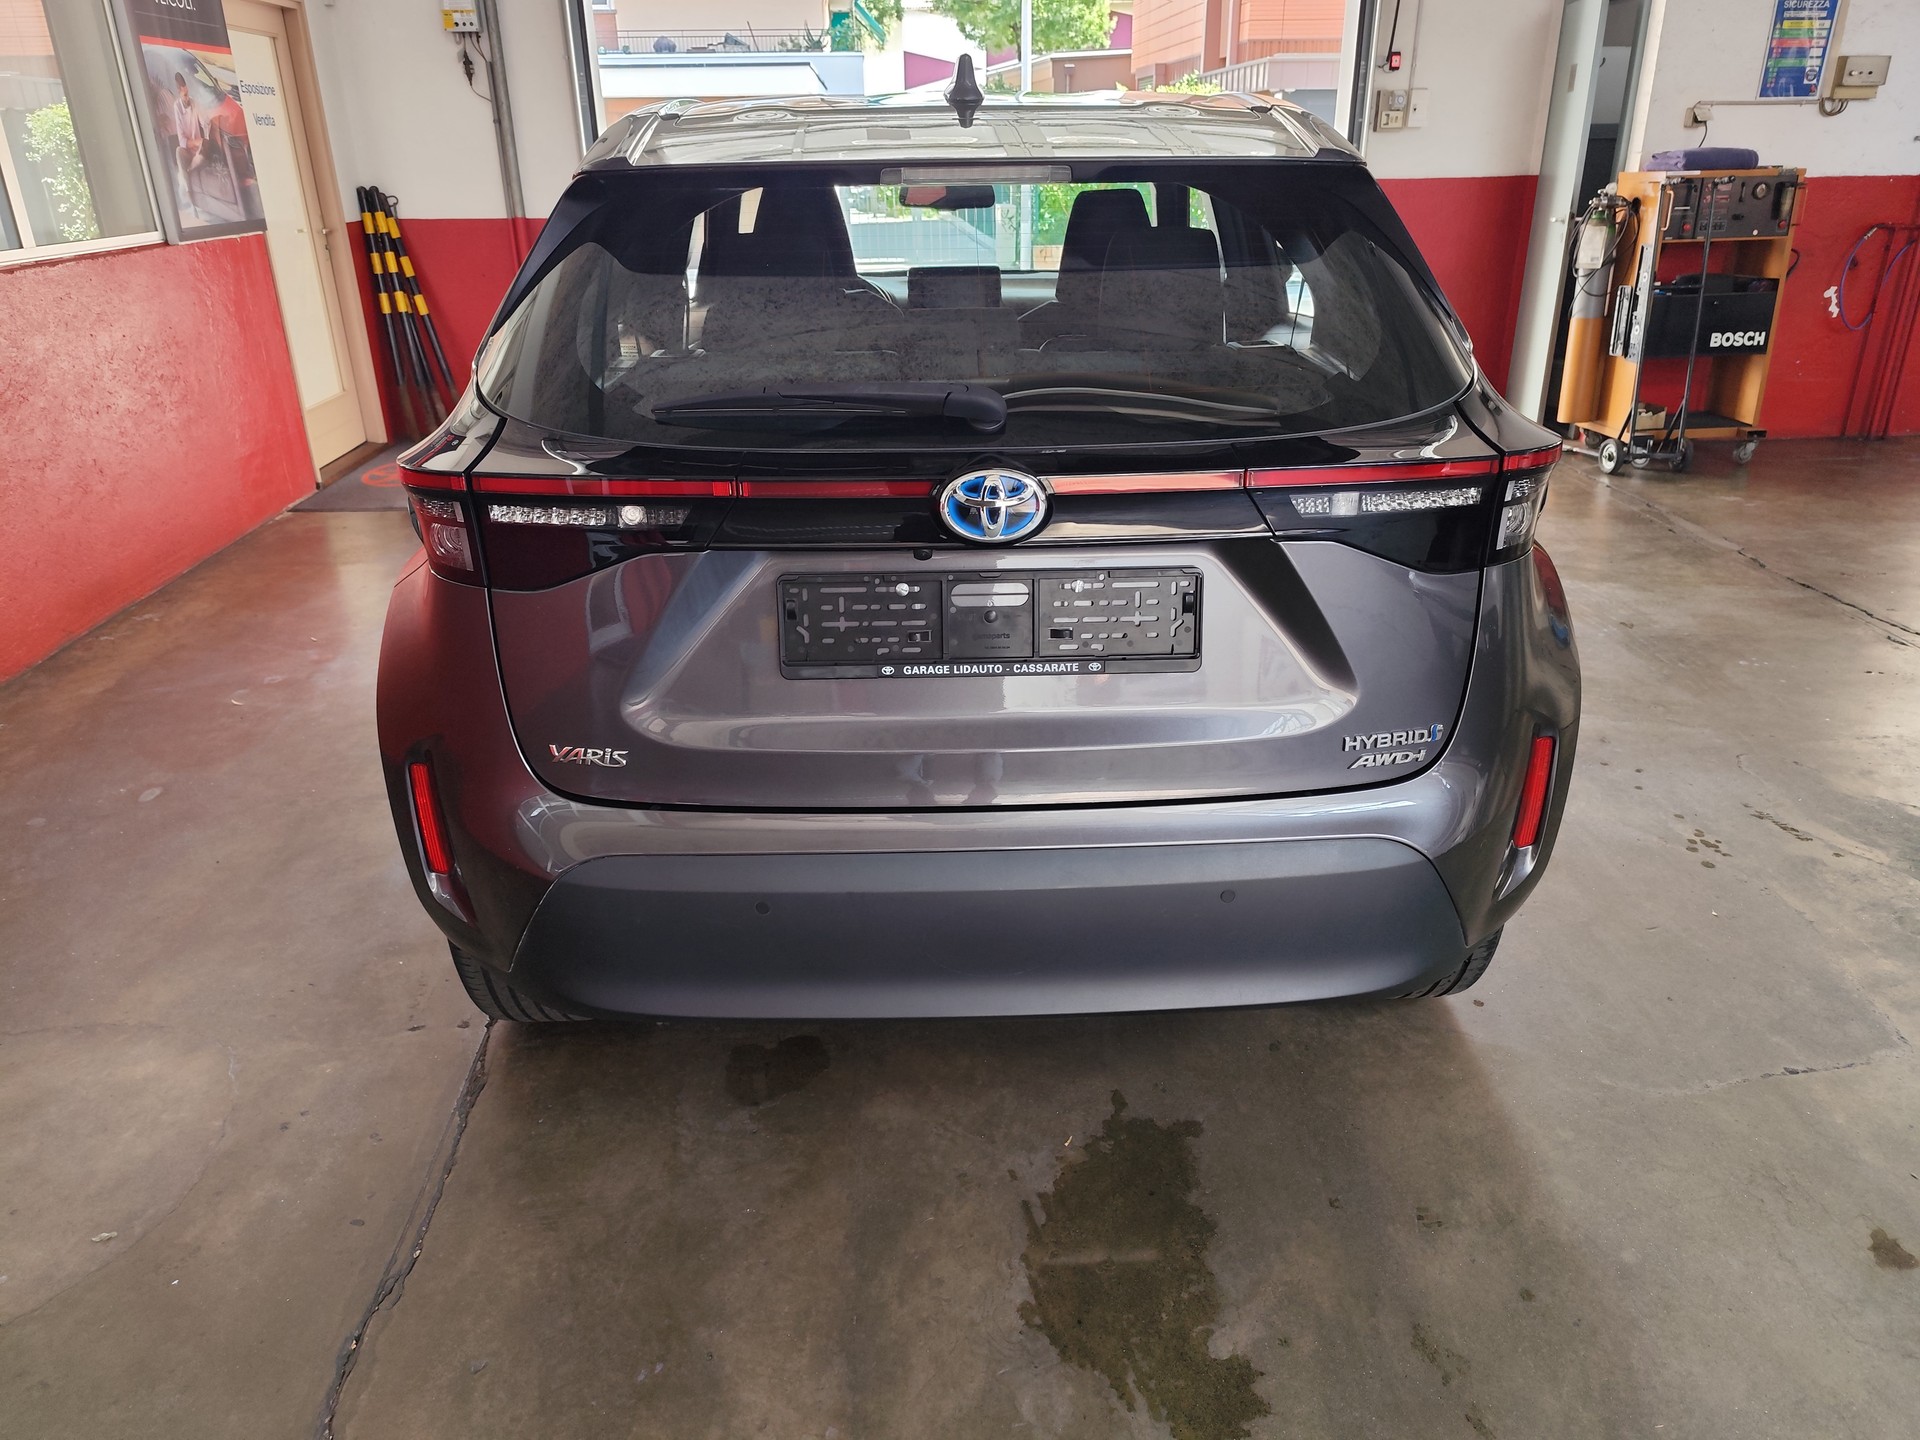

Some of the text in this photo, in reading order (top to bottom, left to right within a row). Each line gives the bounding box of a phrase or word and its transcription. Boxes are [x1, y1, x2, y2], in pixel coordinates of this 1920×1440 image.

[1783, 0, 1830, 9] SICUREZZA
[253, 112, 276, 127] Vendita
[1710, 331, 1766, 348] BOSCH
[903, 665, 950, 675] GARAGE
[953, 664, 1003, 674] LIDAUTO
[1013, 663, 1080, 673] CASSARATE
[1344, 729, 1429, 752] HYBRID
